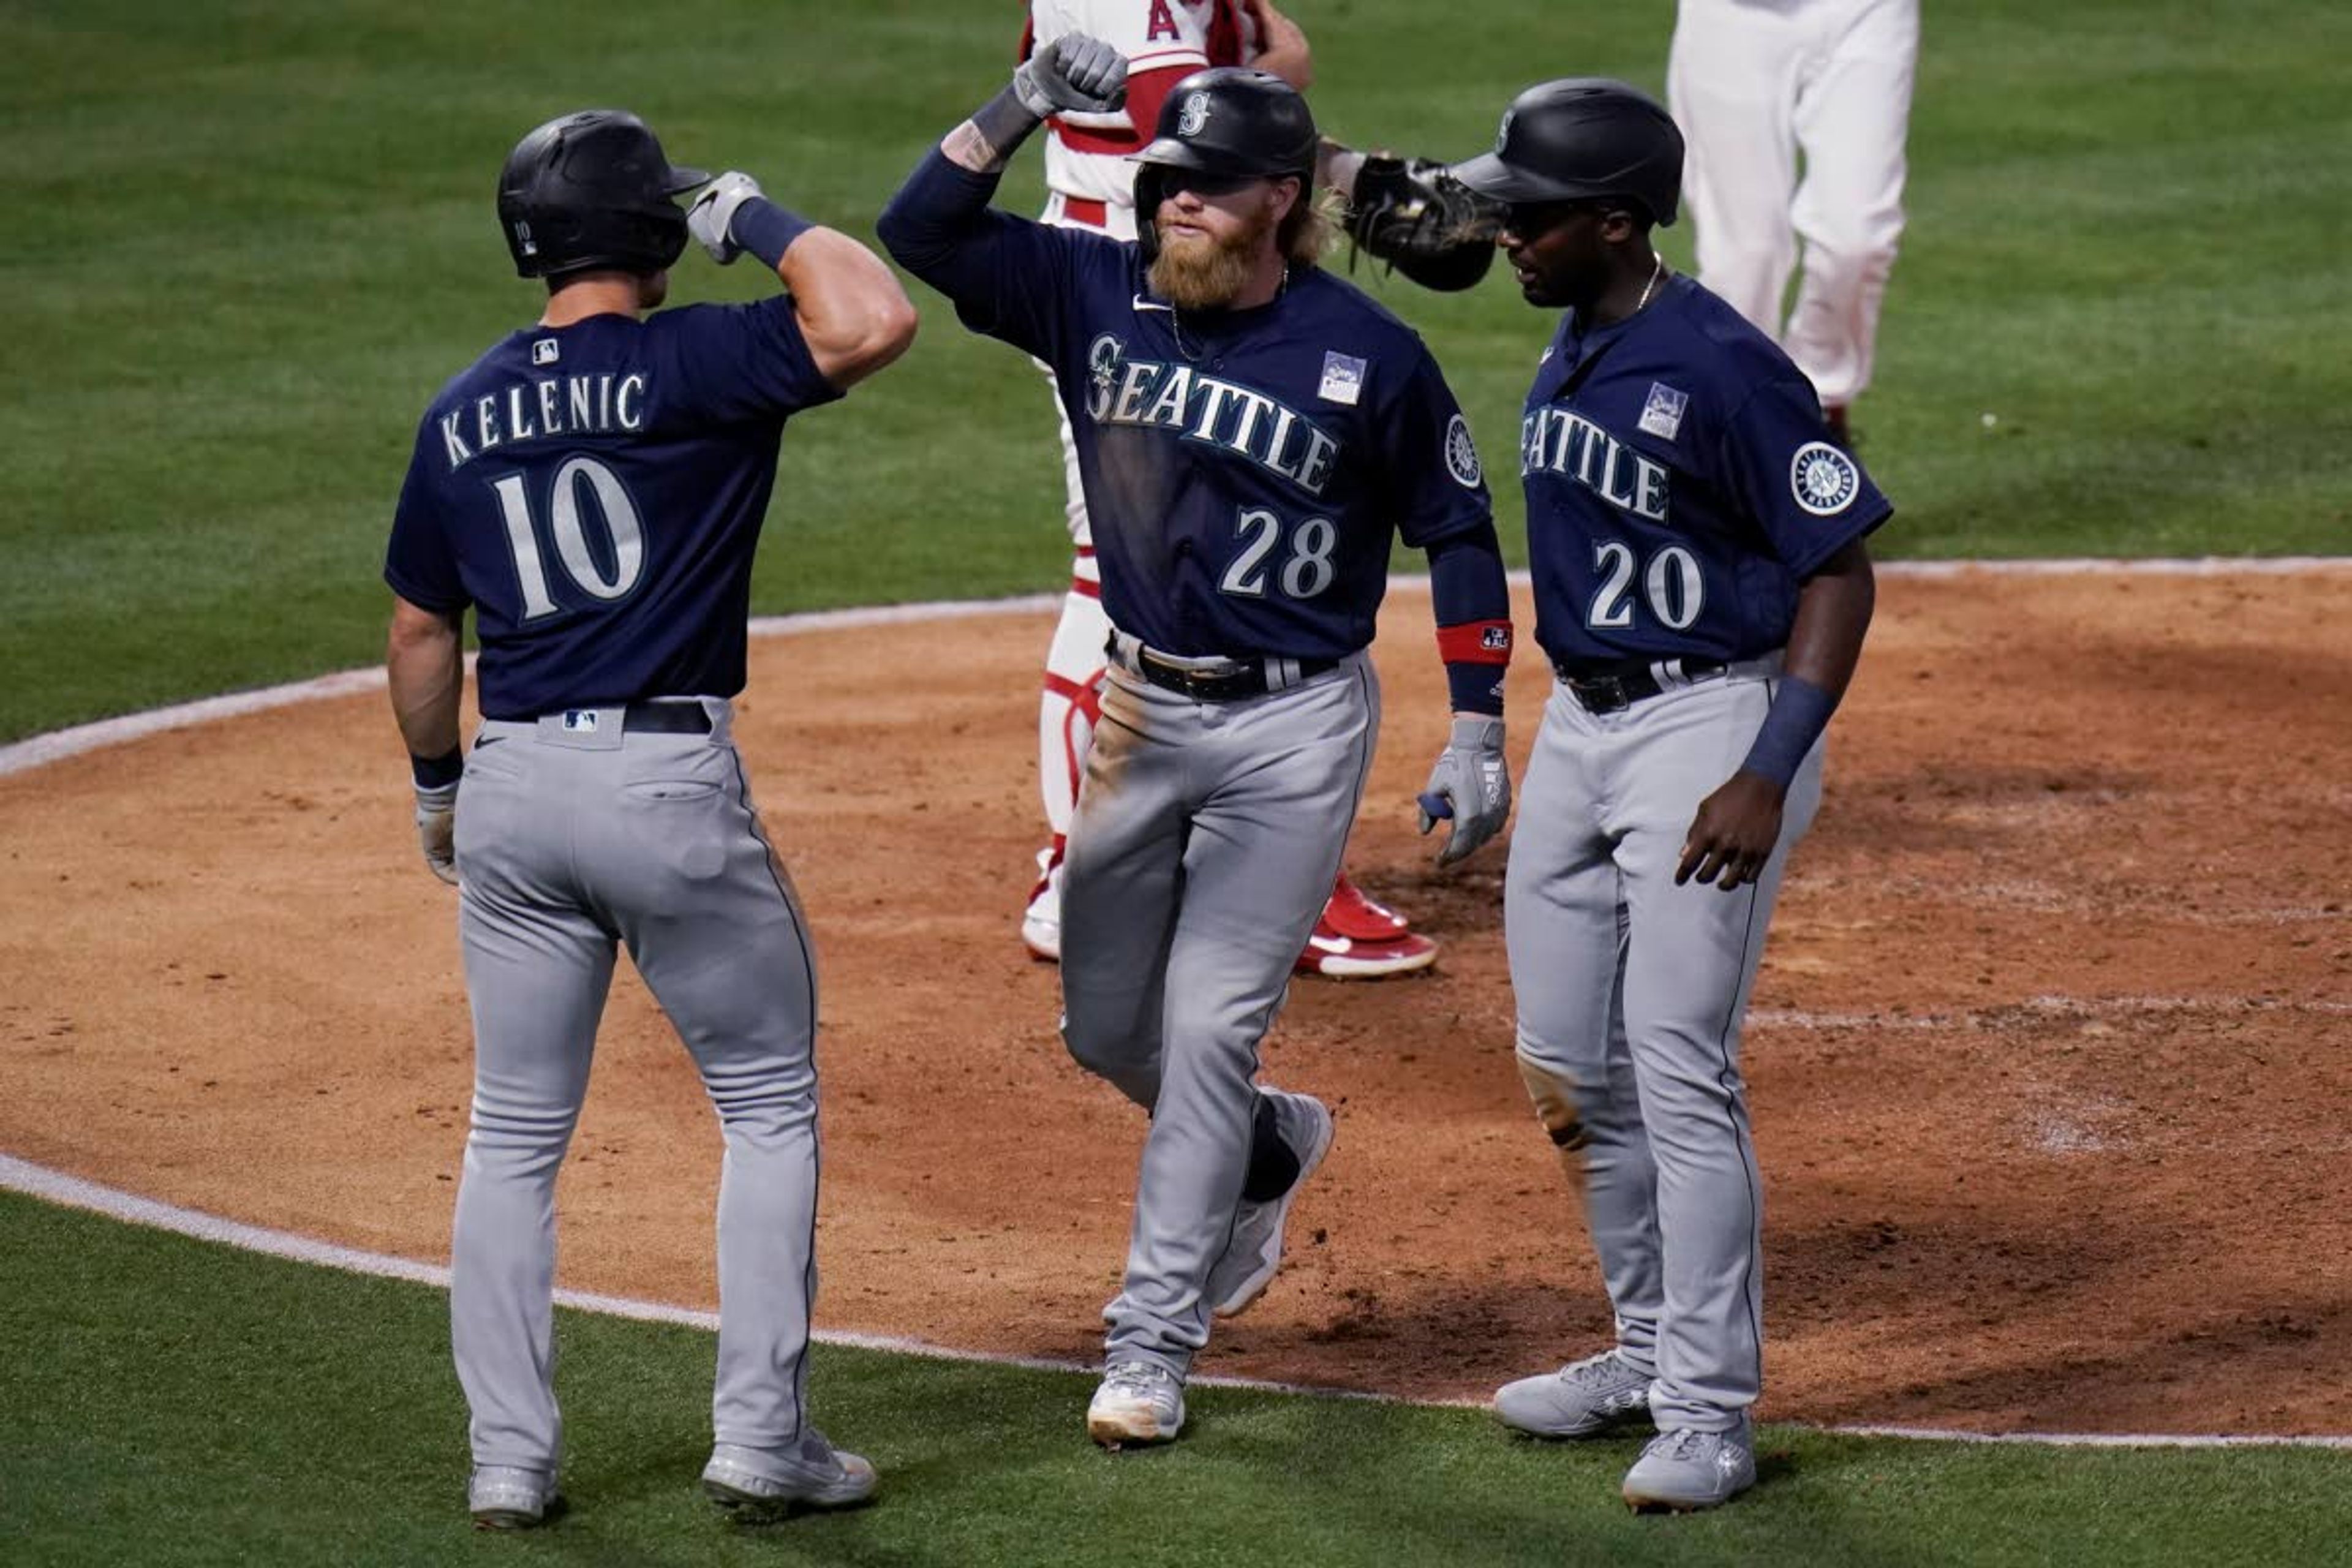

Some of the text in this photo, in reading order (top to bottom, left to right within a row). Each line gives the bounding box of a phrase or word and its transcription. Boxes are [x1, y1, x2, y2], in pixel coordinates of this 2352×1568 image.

[1147, 0, 1180, 40] A
[440, 374, 644, 467] KELENIC
[1084, 333, 1339, 496] SEATTLE
[492, 453, 649, 626] 10
[1218, 506, 1340, 601] 28
[1585, 541, 1706, 632] 20
